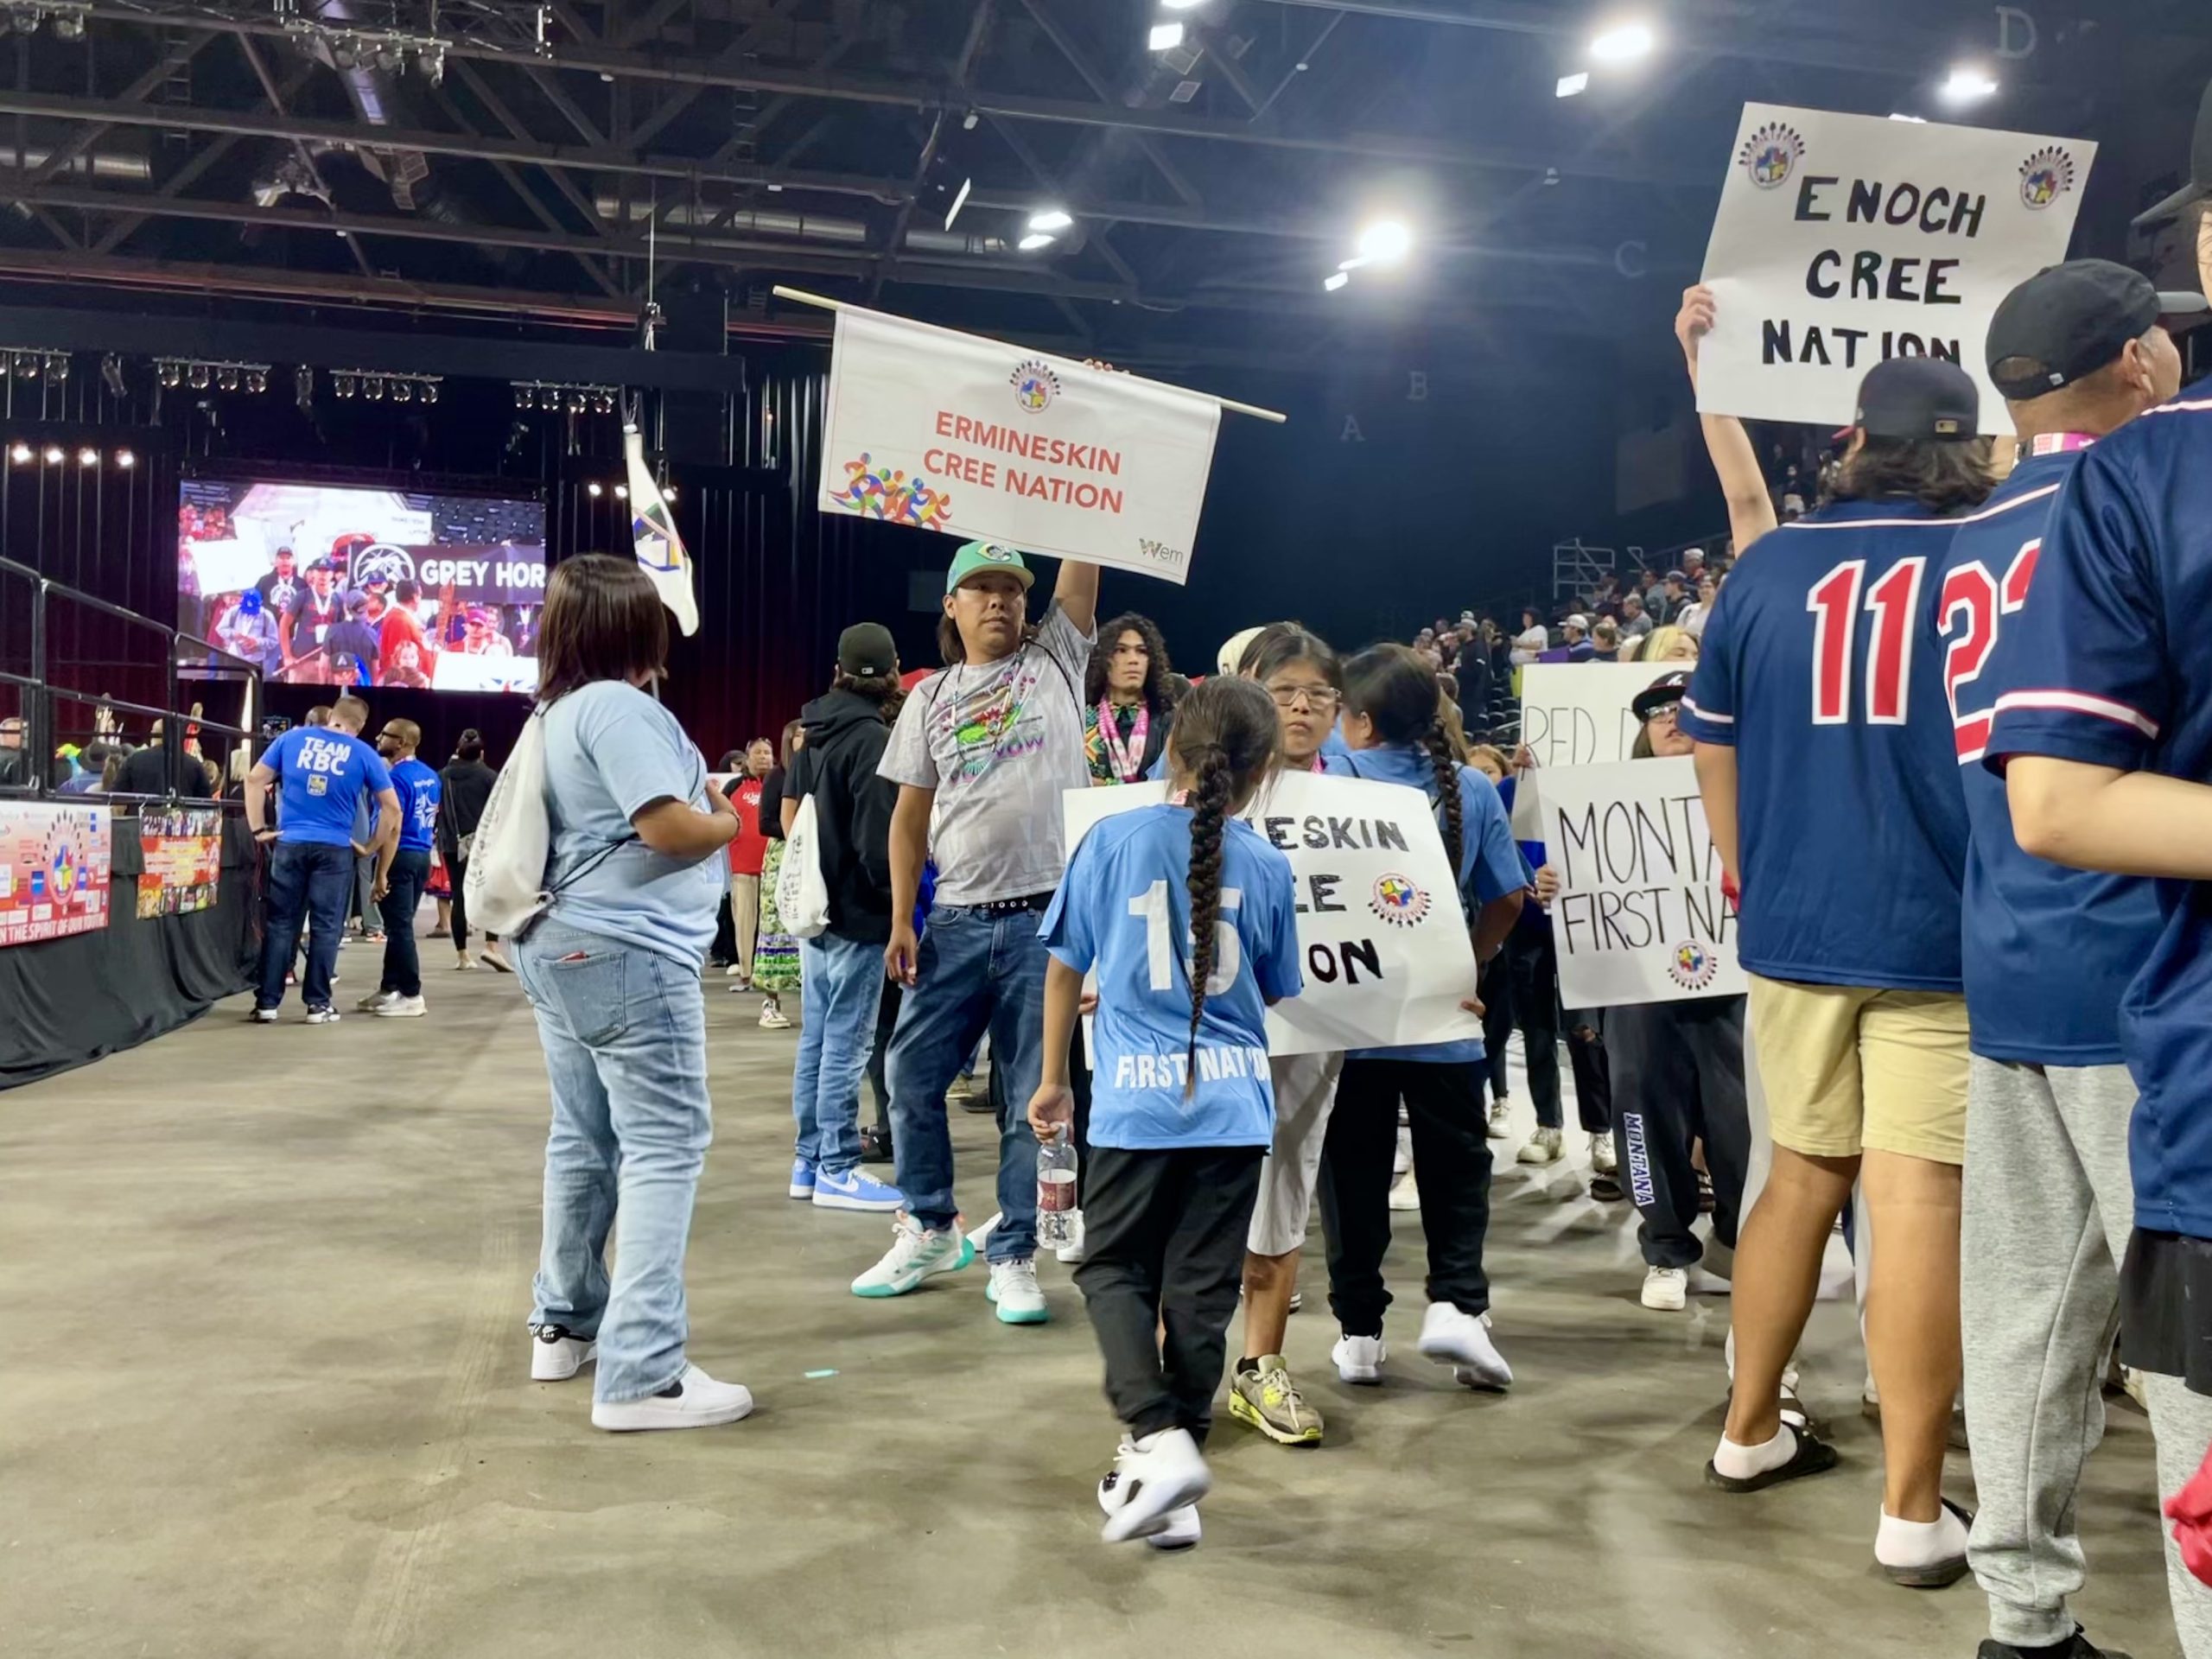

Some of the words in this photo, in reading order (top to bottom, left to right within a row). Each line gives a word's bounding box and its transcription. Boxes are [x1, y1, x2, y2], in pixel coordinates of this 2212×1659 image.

[1994, 5, 2037, 59] D
[1795, 175, 1986, 238] ENOCH
[1615, 240, 1647, 277] C
[1806, 249, 1961, 304] CREE
[1407, 372, 1430, 401] B
[934, 410, 1122, 475] ERMINESKIN
[1340, 415, 1365, 442] A
[923, 448, 995, 489] CREE
[1005, 467, 1123, 514] NATION
[420, 559, 490, 587] GREY
[495, 562, 546, 588] HOR
[1806, 556, 1927, 725] 11
[1937, 537, 2043, 765] 2
[296, 748, 346, 776] RBC
[304, 736, 352, 763] TEAM
[1245, 815, 1410, 852] ESKIN
[9, 925, 29, 943] THE
[1128, 879, 1243, 996] 15
[1560, 887, 1671, 955] FIRST
[1114, 1053, 1189, 1089] FIRST
[1624, 1111, 1656, 1207] MONTANA
